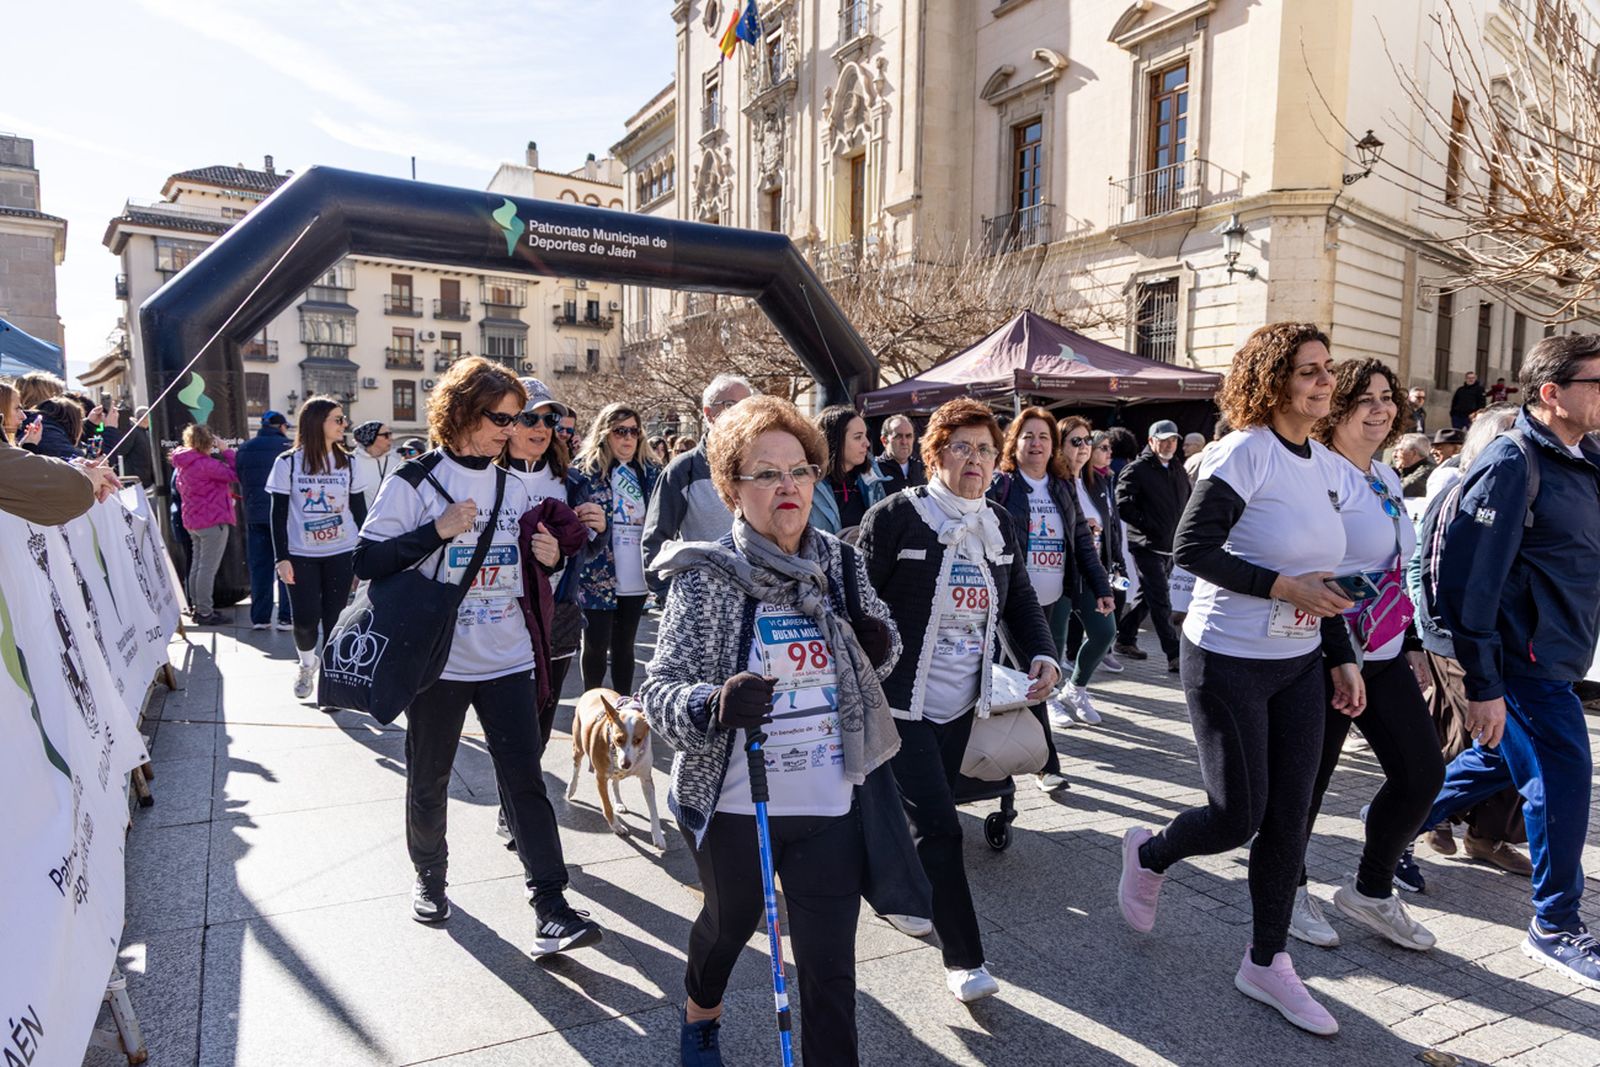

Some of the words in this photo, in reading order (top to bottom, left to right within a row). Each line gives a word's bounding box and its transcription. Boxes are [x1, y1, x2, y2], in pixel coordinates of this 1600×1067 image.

[529, 220, 590, 239] Patronato
[592, 228, 650, 248] Municipal
[652, 236, 667, 249] de
[529, 235, 586, 253] Deportes
[589, 242, 605, 255] de
[607, 244, 637, 259] Jaén
[312, 526, 338, 540] 1057
[1032, 551, 1063, 566] 1002
[471, 566, 500, 588] 17
[952, 587, 989, 609] 988
[772, 629, 800, 641] BUENA
[799, 627, 821, 639] MUE
[787, 640, 834, 672] 98
